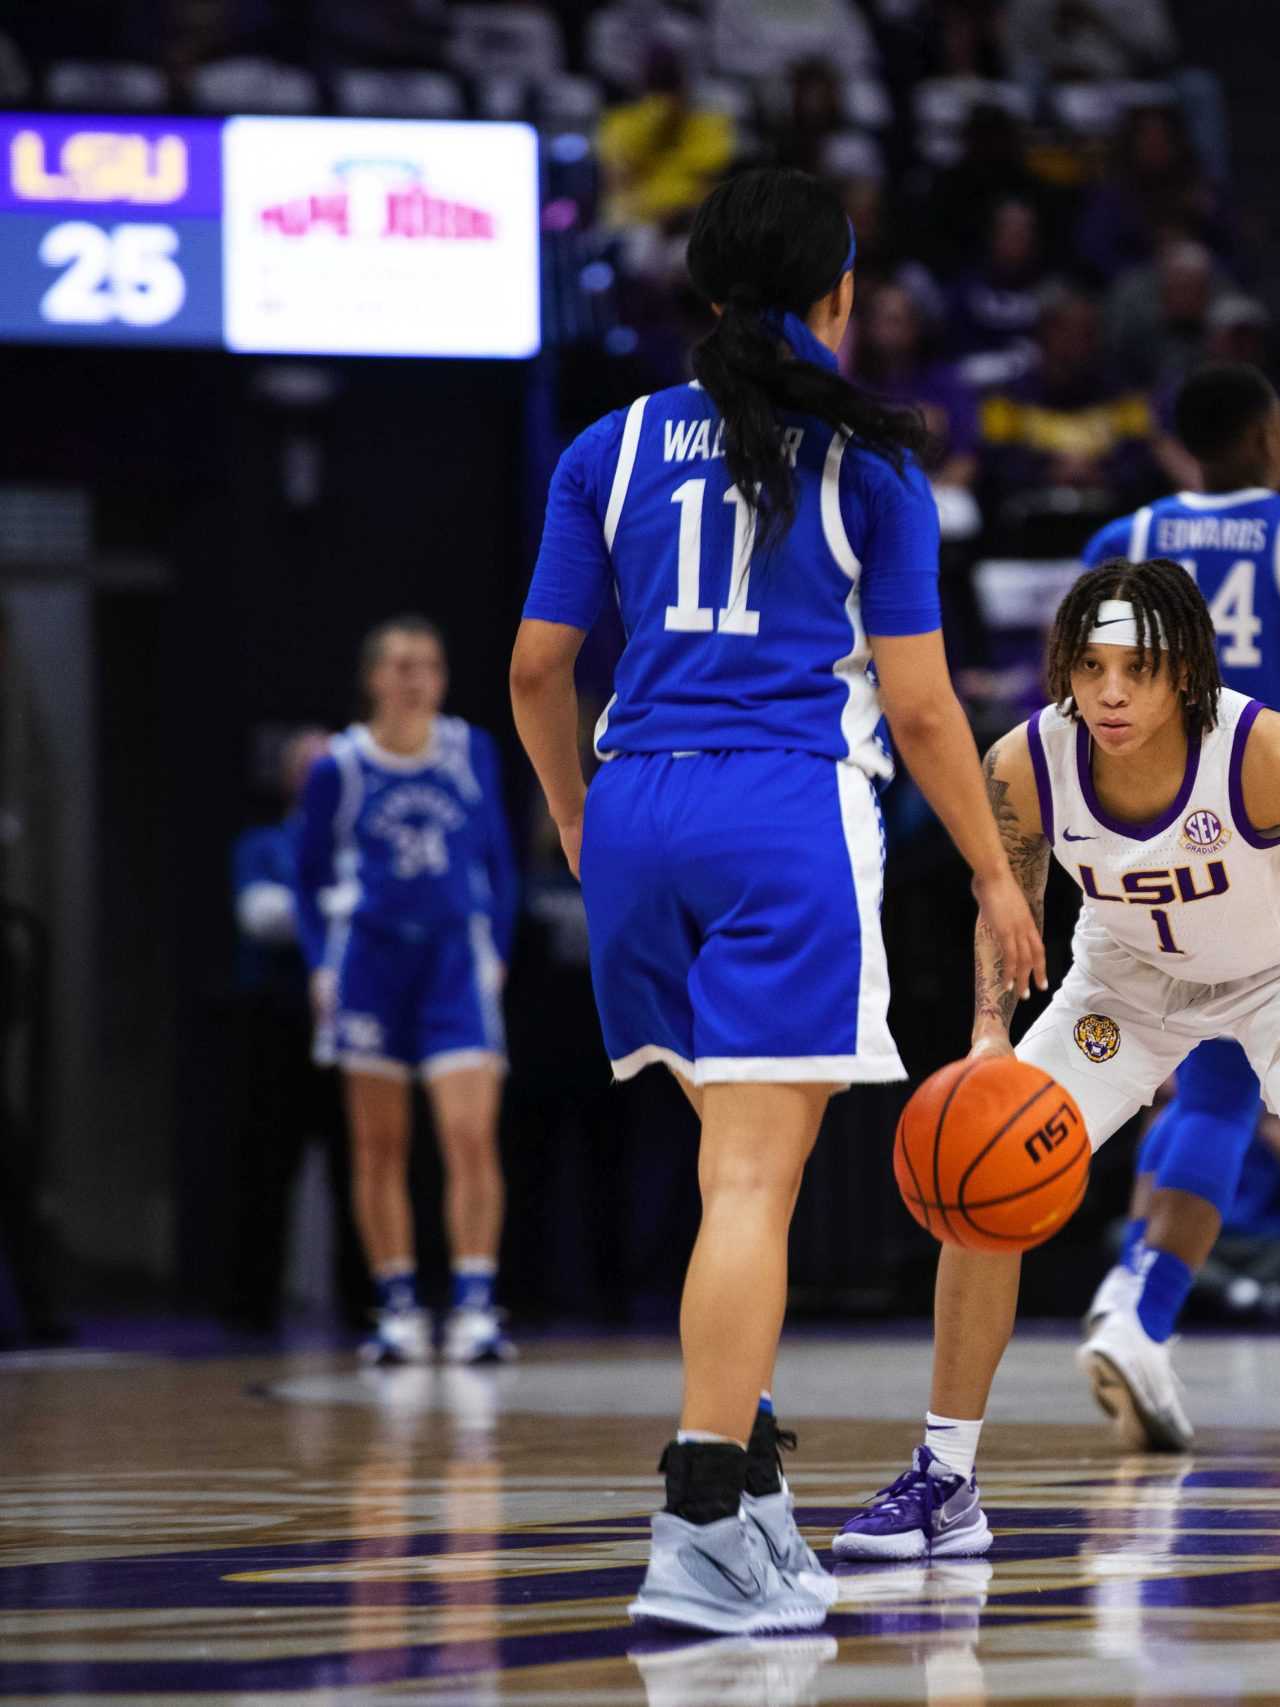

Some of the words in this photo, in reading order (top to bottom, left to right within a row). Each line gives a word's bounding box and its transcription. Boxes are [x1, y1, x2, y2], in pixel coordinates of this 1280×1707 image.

[10, 130, 188, 204] LSU
[39, 220, 187, 326] 25
[663, 418, 804, 468] WALR
[664, 478, 761, 636] 11
[1157, 517, 1268, 552] EDWARDS
[1181, 558, 1263, 668] 4
[1183, 838, 1227, 856] GRADUATE
[1185, 810, 1221, 845] SEC
[1076, 860, 1230, 906] LSU
[1150, 908, 1186, 956] 1
[1024, 1103, 1078, 1165] LSU
